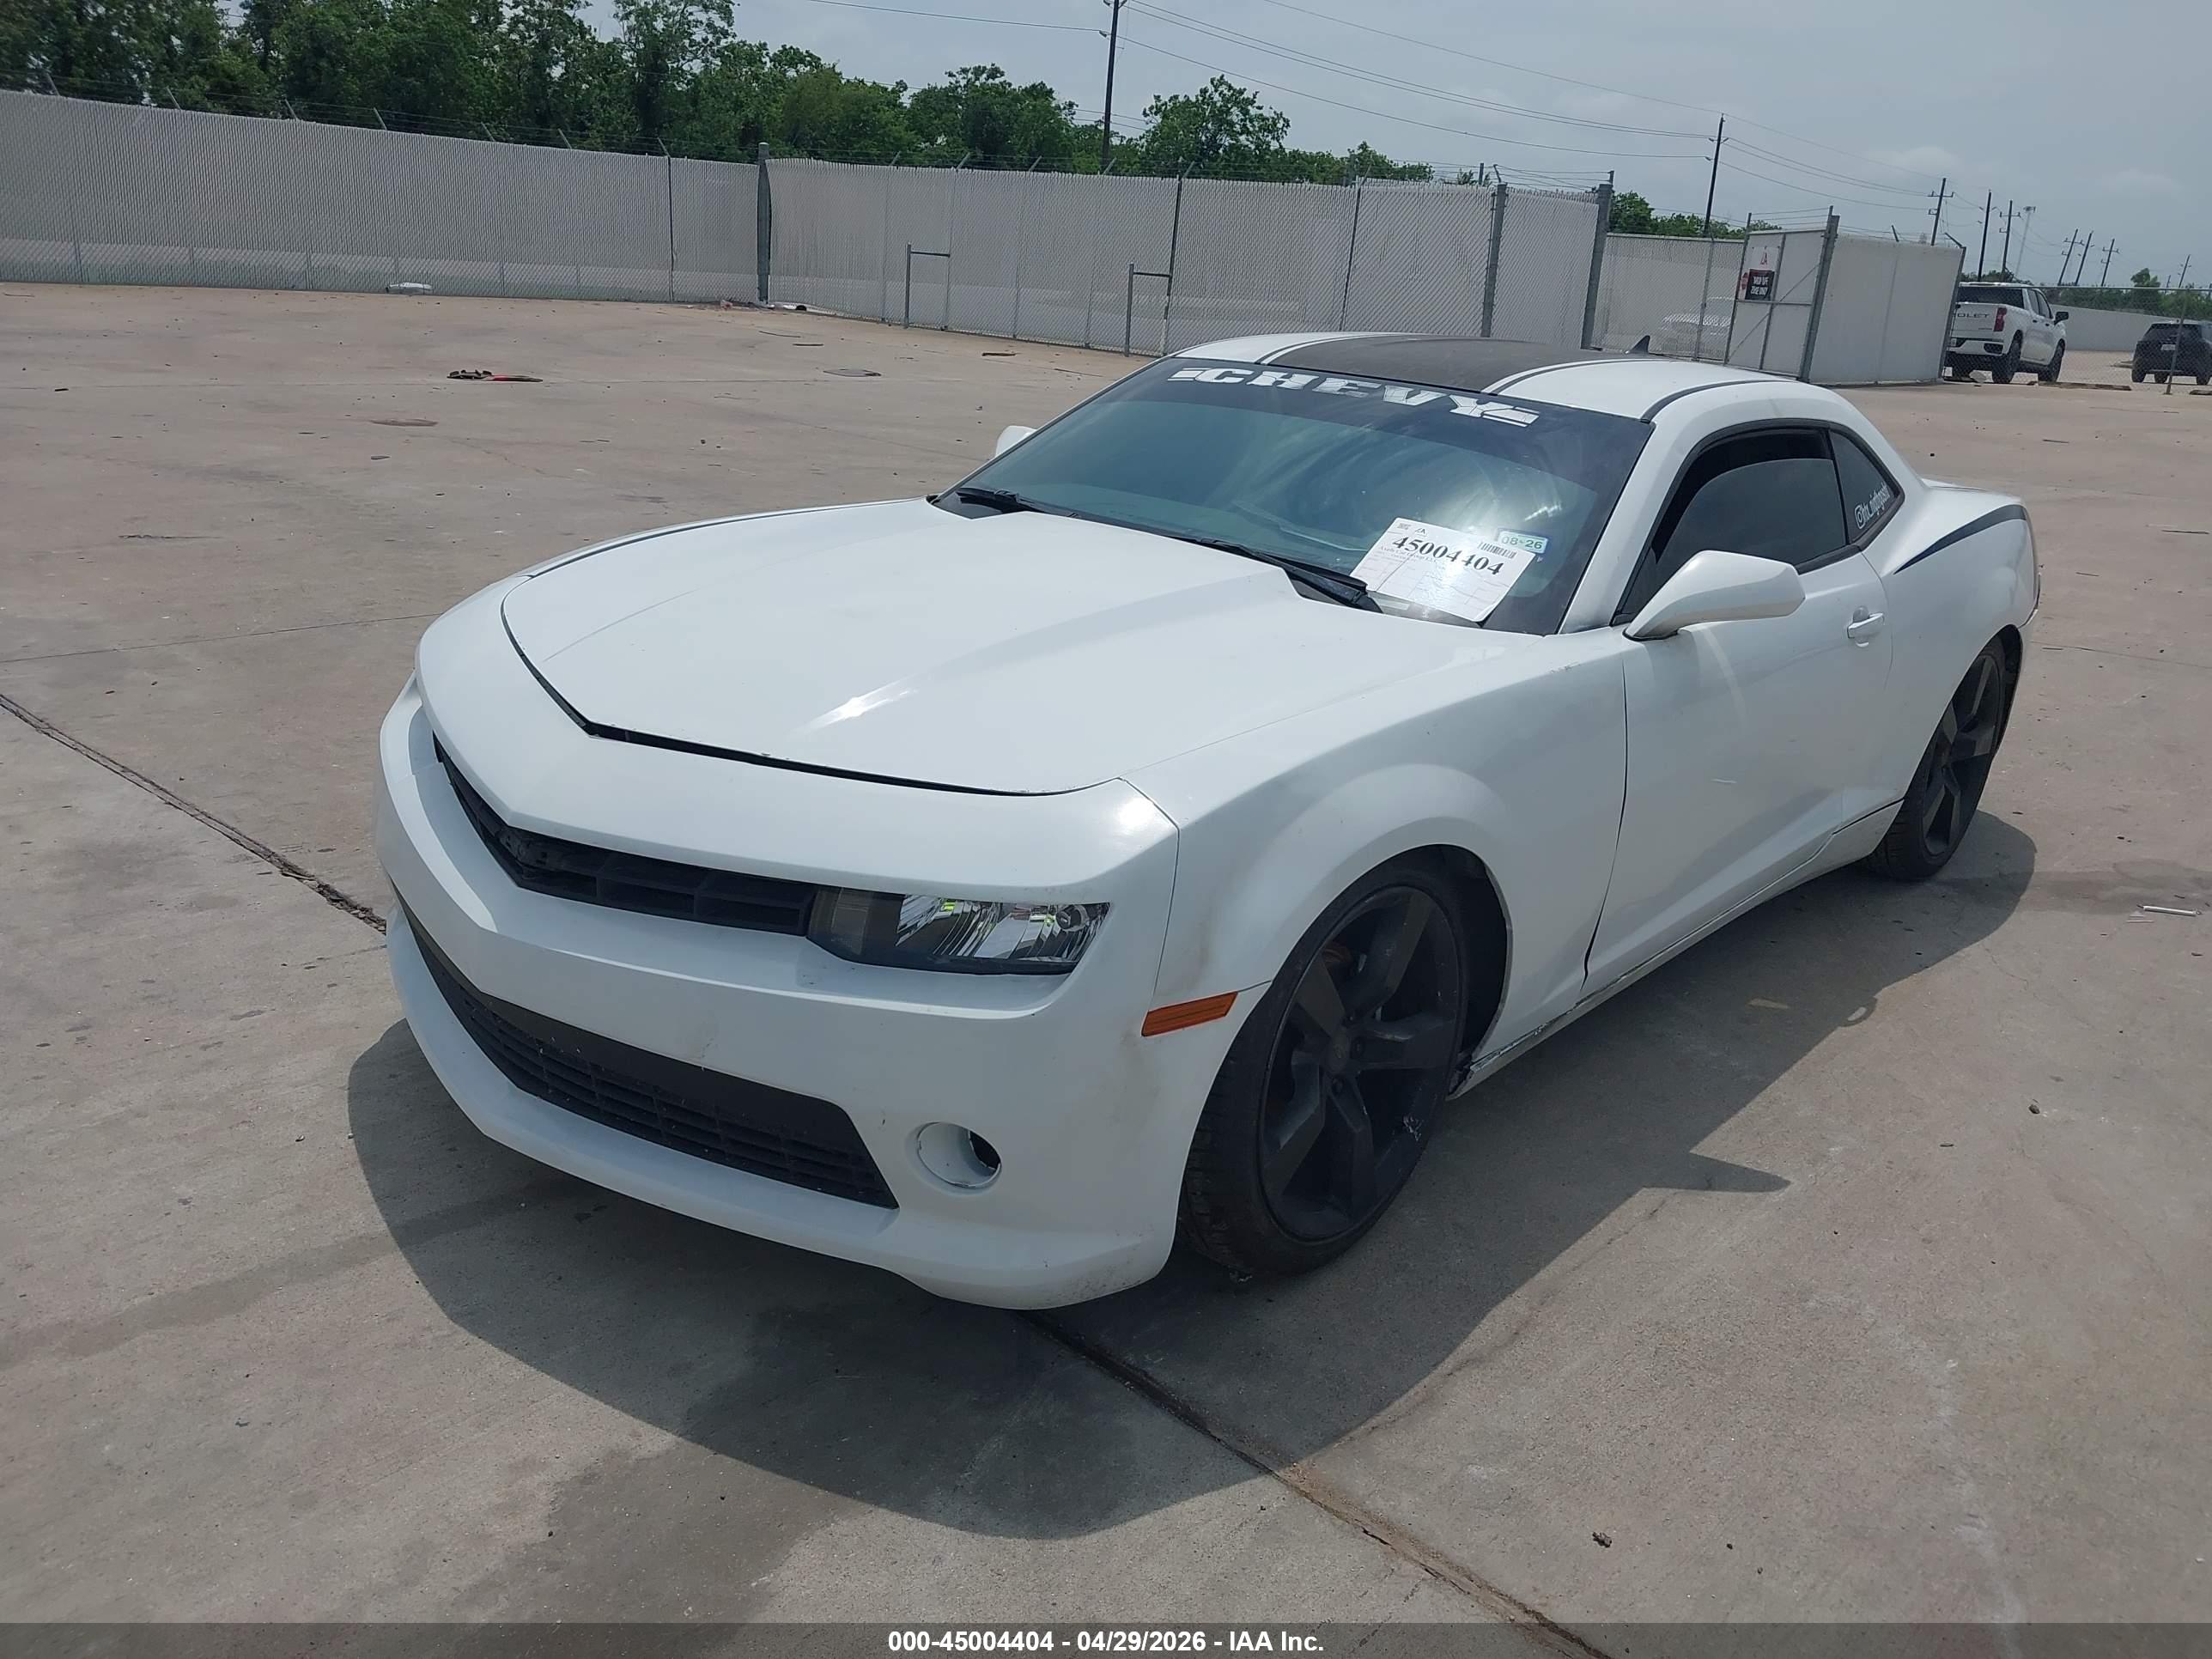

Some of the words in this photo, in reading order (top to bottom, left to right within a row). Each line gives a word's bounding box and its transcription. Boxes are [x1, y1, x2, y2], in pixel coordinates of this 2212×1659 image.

[1168, 367, 1540, 428] CHEVY
[1392, 536, 1504, 575] 45004404
[1501, 536, 1543, 550] 08-26
